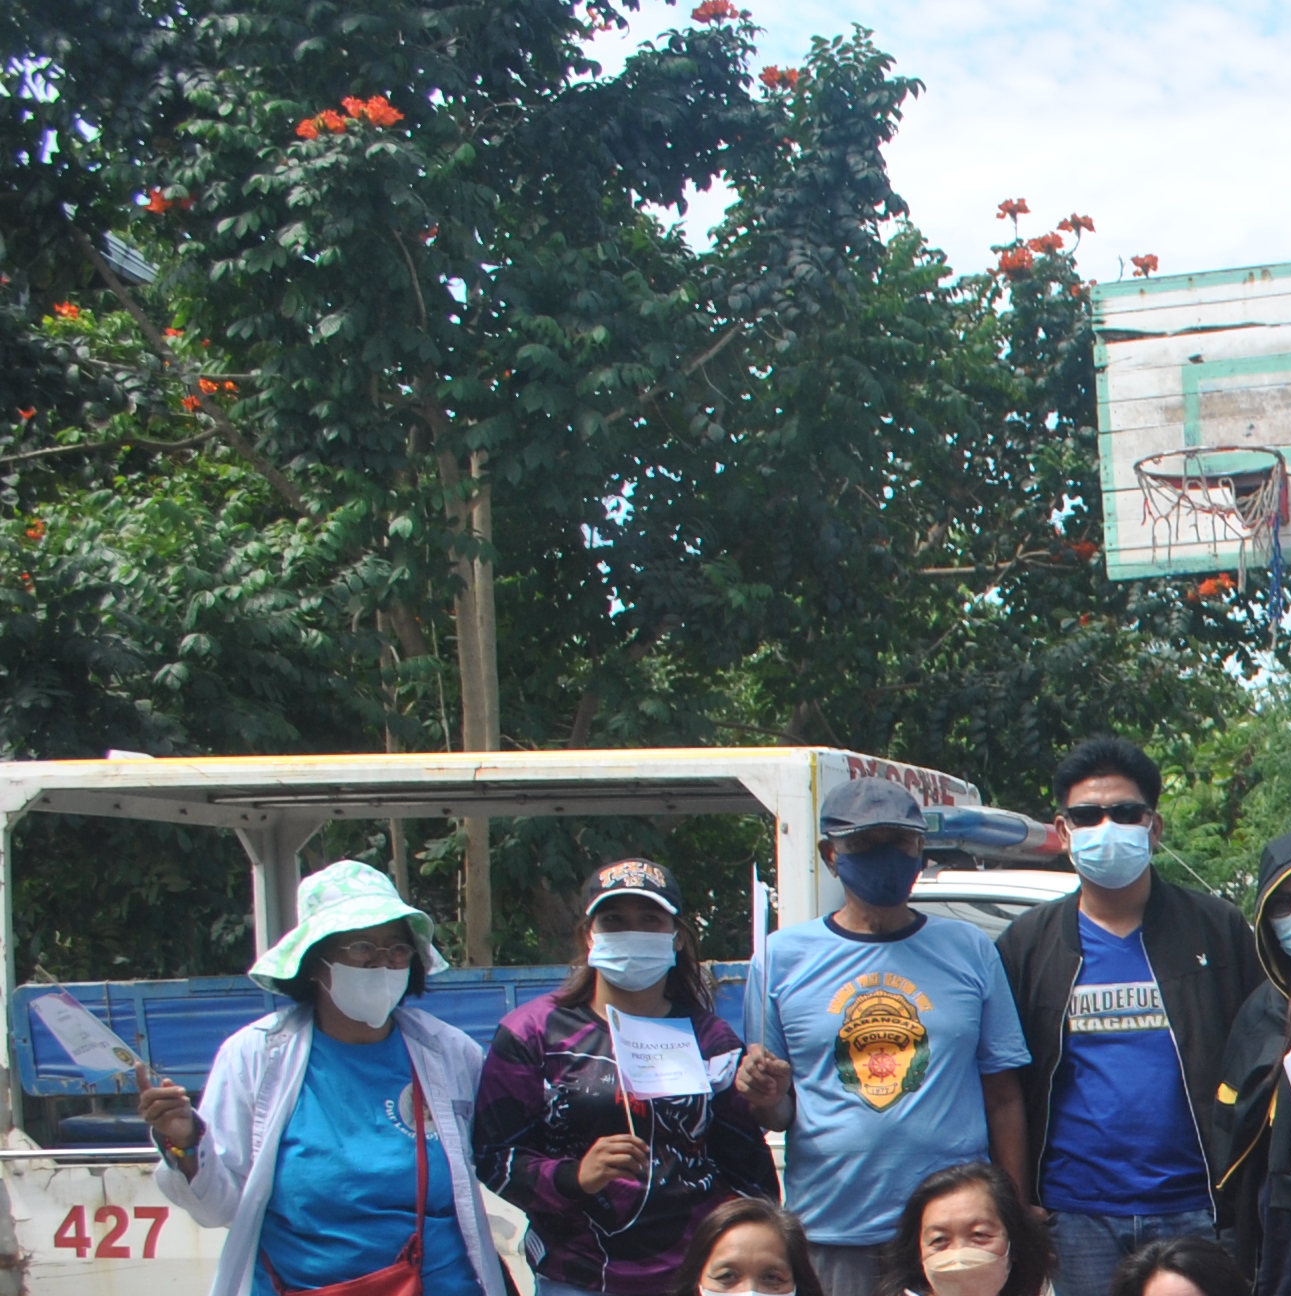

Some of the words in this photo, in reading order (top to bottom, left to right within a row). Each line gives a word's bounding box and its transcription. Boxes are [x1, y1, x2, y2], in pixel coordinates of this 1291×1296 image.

[844, 1017, 919, 1032] BARANGAY
[862, 1032, 902, 1041] POLICE
[54, 1205, 169, 1259] 427
